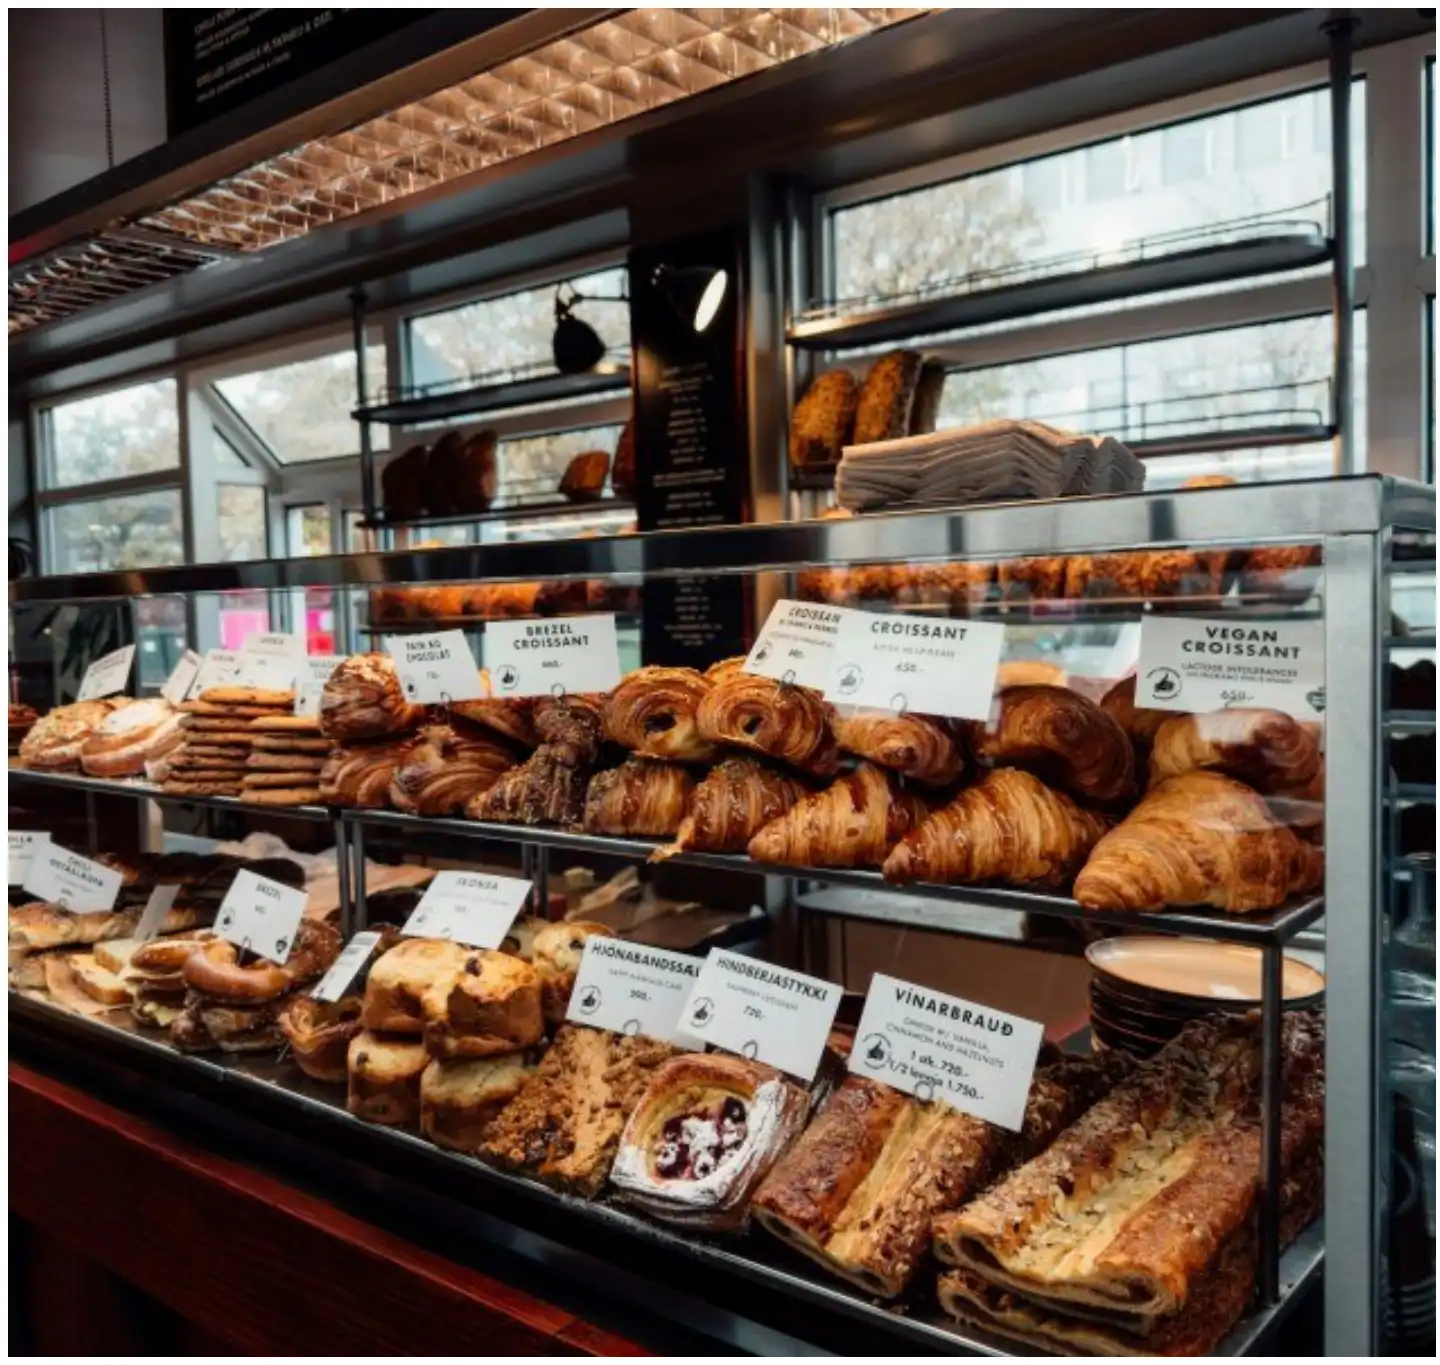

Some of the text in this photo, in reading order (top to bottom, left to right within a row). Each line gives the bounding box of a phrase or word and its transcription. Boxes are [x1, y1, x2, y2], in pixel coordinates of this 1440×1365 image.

[869, 620, 969, 641] CROISSANT
[1204, 625, 1279, 643] VEGAN
[512, 634, 590, 650] CROISSANT
[1180, 638, 1301, 660] CROISSANT
[895, 987, 1014, 1037] VÍNARBRAUÐ
